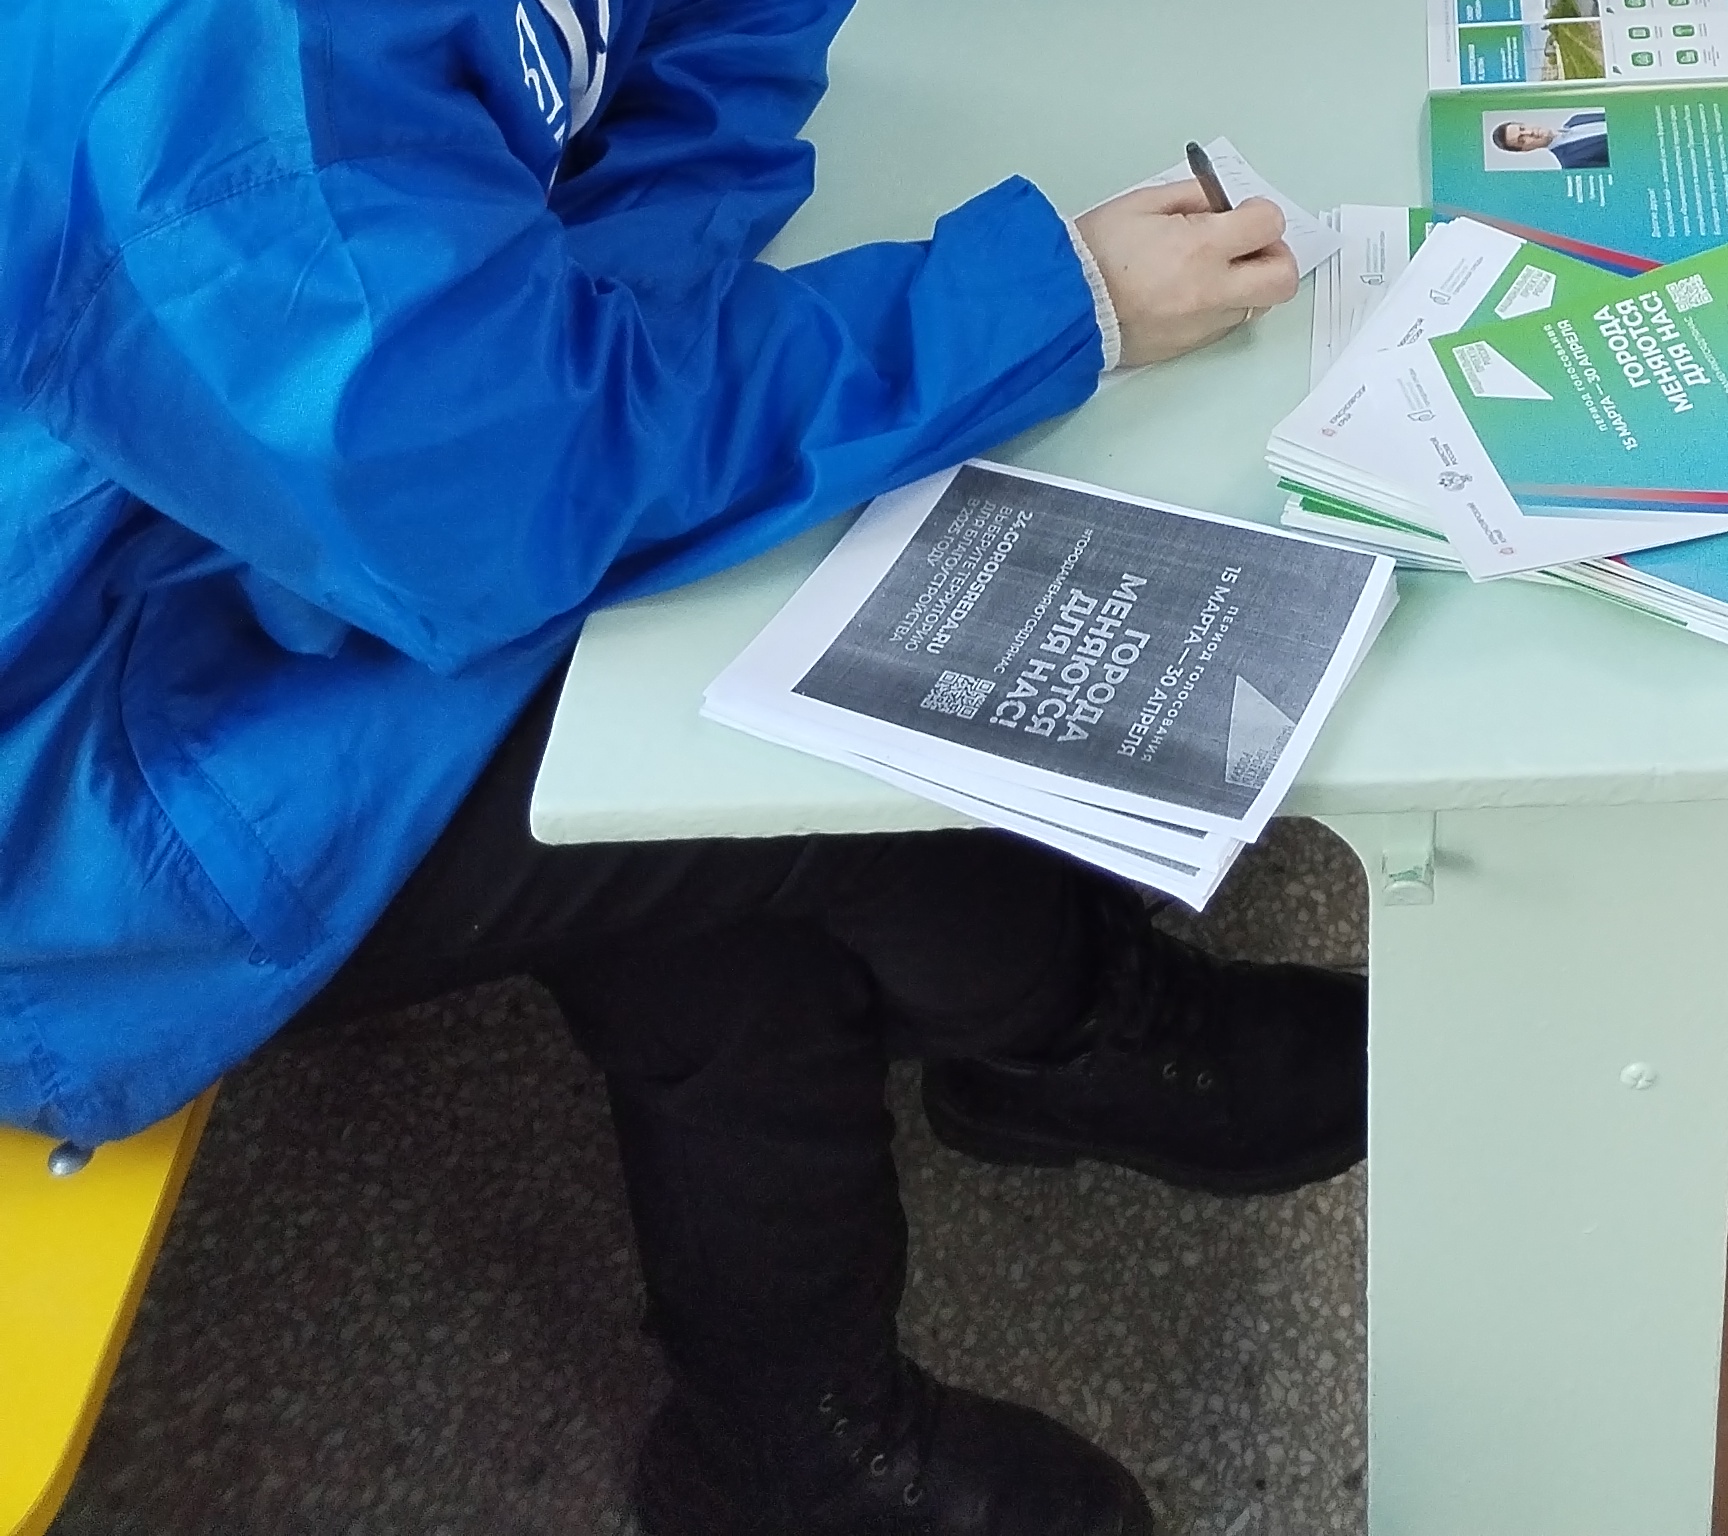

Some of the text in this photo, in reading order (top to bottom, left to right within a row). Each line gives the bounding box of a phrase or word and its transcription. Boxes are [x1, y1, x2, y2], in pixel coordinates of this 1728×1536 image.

[1541, 321, 1609, 433] ПЕРИОД ГОЛОСОВАНИЯ
[1555, 316, 1594, 370] АПРЕЛЯ
[1582, 364, 1602, 386] 30
[1590, 302, 1652, 388] ГОРОДА
[1613, 296, 1695, 415] МЕНЯЮТСЯ
[1637, 288, 1712, 389] ДЛЯ НАС!
[1598, 393, 1632, 440] МАРТА
[1620, 433, 1639, 452] 15
[887, 499, 996, 644] ДЛЯ БЛАГОУСТРОЙСТВА
[902, 505, 1013, 653] ВЫБЕРИТЕ ТЕРРИТОРИЮ
[923, 494, 980, 568] В 2025 ГОДУ
[1218, 566, 1242, 586] 15
[923, 509, 1033, 656] 24.GORODSREDA.RU
[991, 527, 1094, 676] #ГОРОДАМЕНЯЮТСЯДЛЯНАС
[1182, 586, 1230, 643] МАРТА
[988, 587, 1098, 728] ДЛЯ НАС!
[1022, 572, 1148, 737] МЕНЯЮТСЯ
[1055, 628, 1151, 741] ГОРОДА
[1138, 604, 1239, 763] ПЕРИОД ГОЛОСОВАНИЯ
[1157, 663, 1184, 688] 30
[1115, 685, 1168, 757] АПРЕЛЯ
